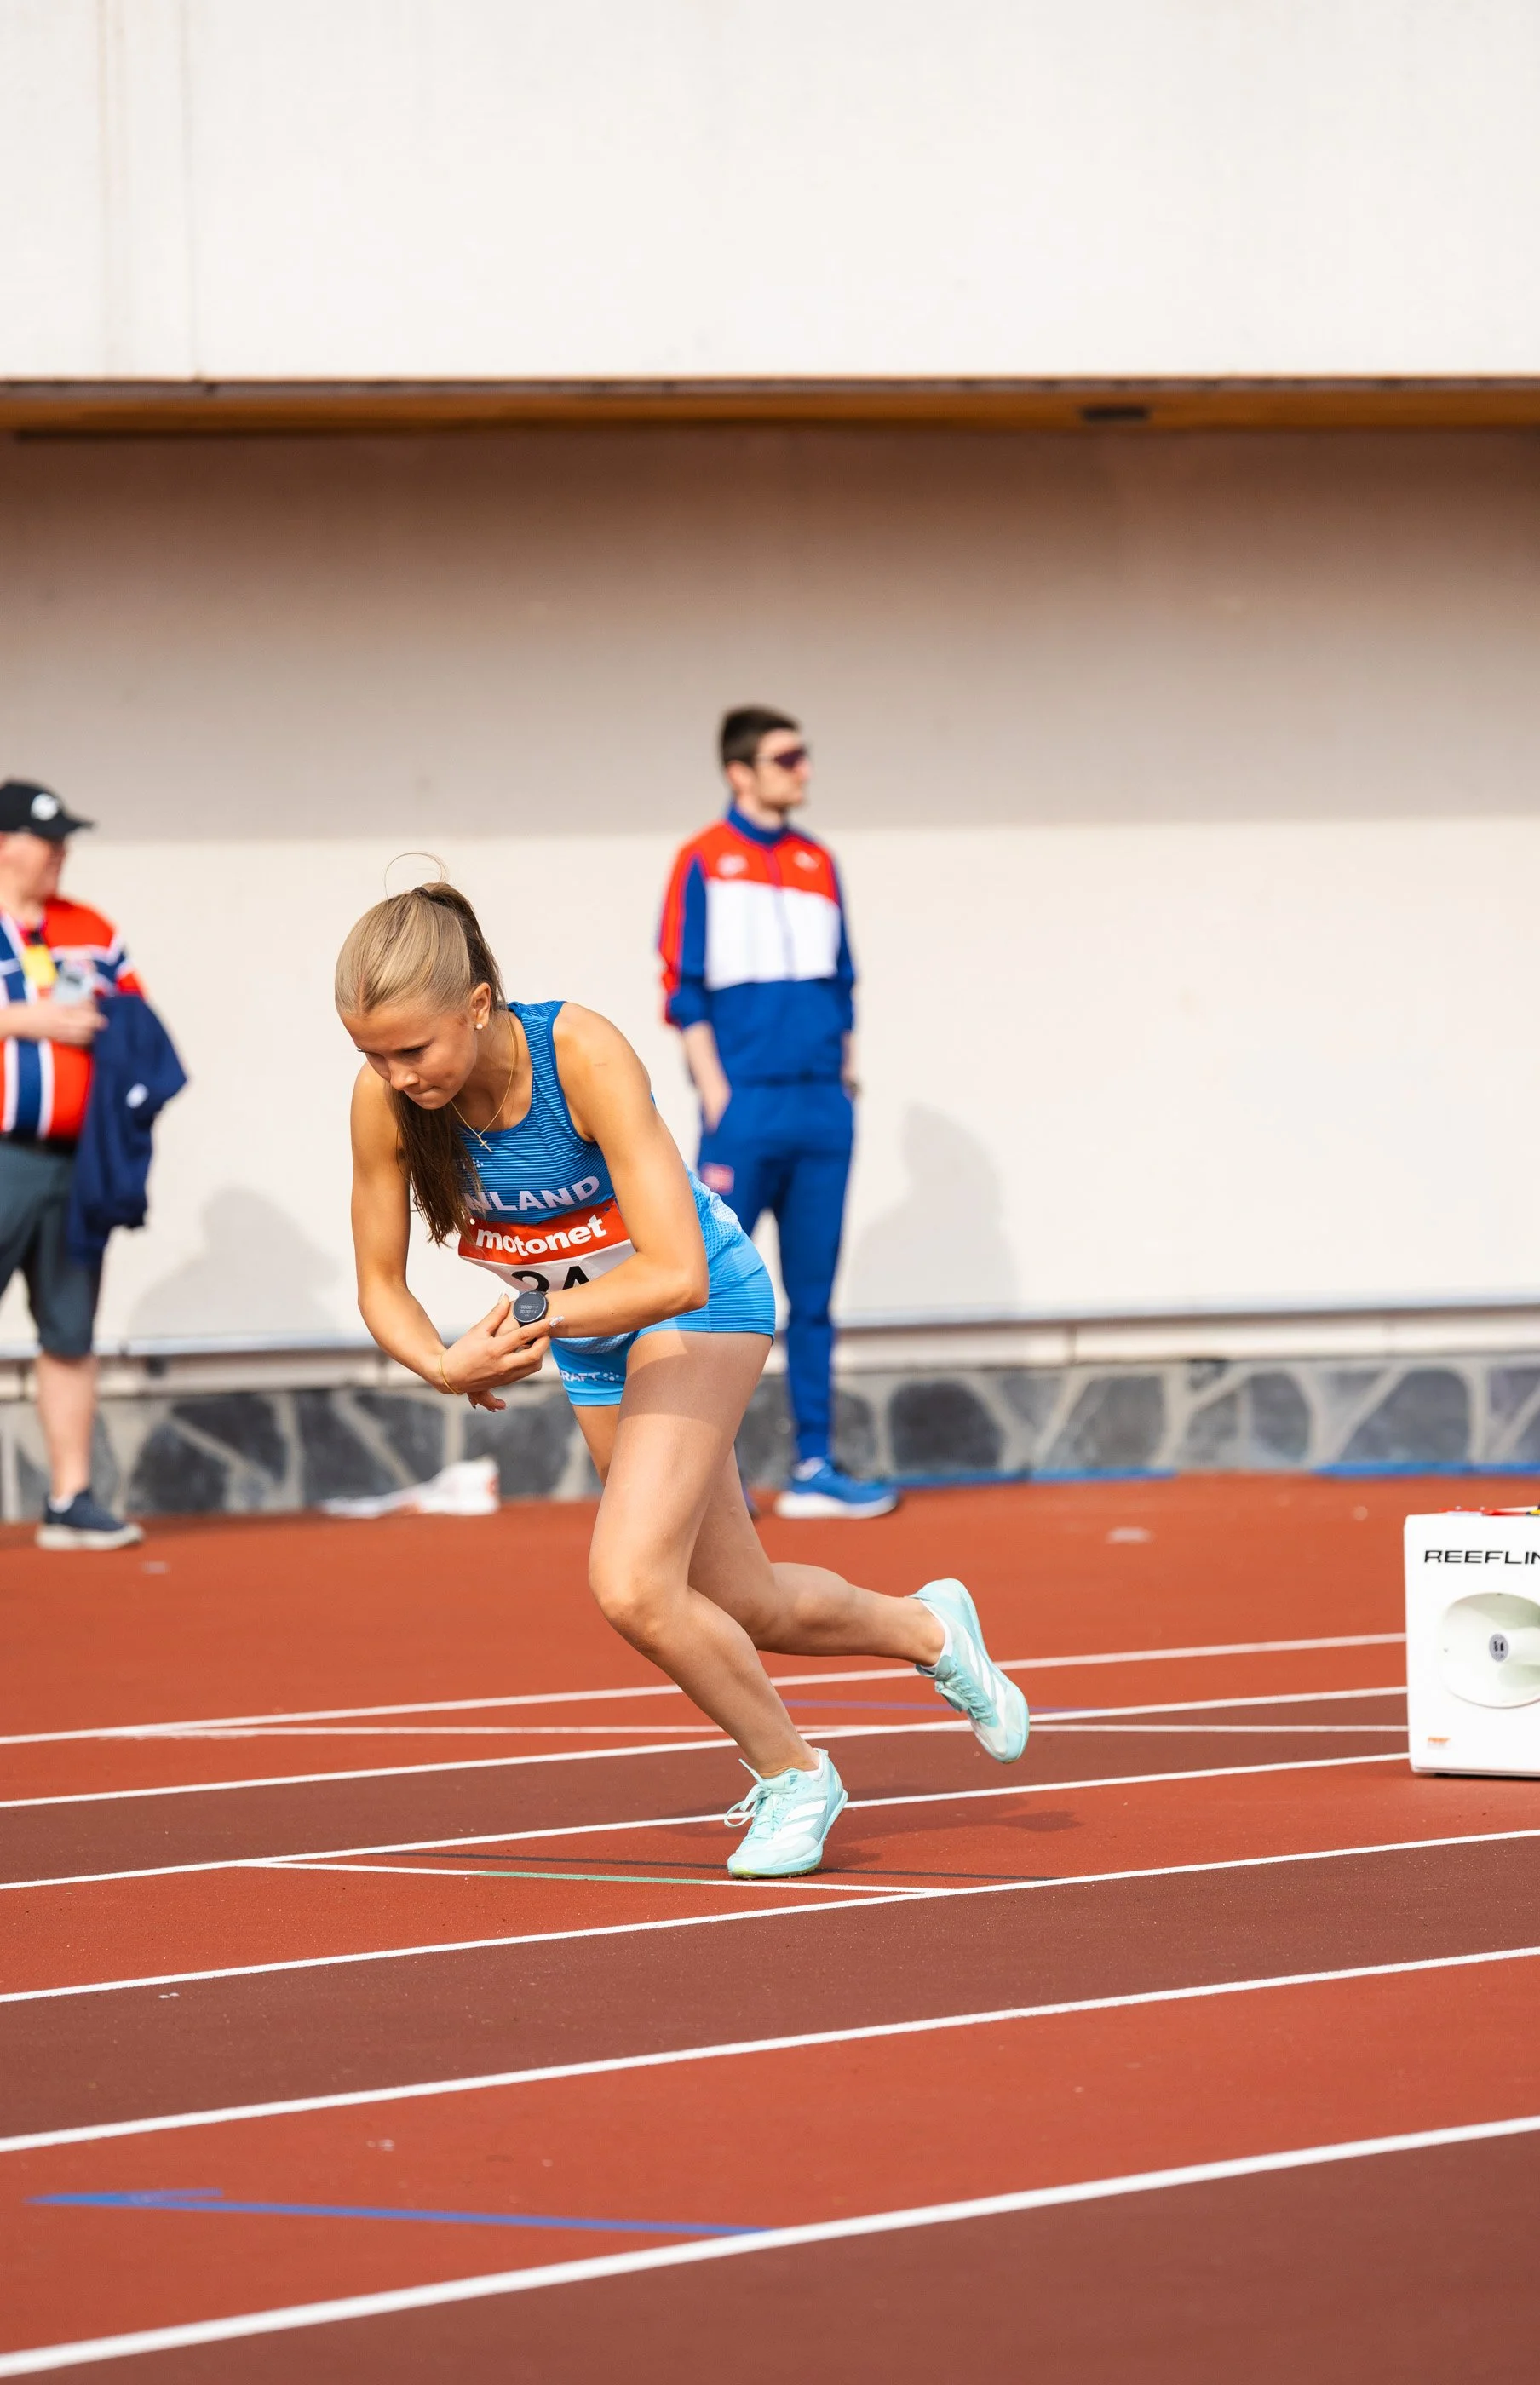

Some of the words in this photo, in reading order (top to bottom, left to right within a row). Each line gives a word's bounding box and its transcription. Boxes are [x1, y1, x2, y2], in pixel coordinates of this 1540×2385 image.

[465, 1175, 600, 1211] NLAND
[475, 1214, 607, 1256] motonet
[559, 1369, 600, 1382] RAFT
